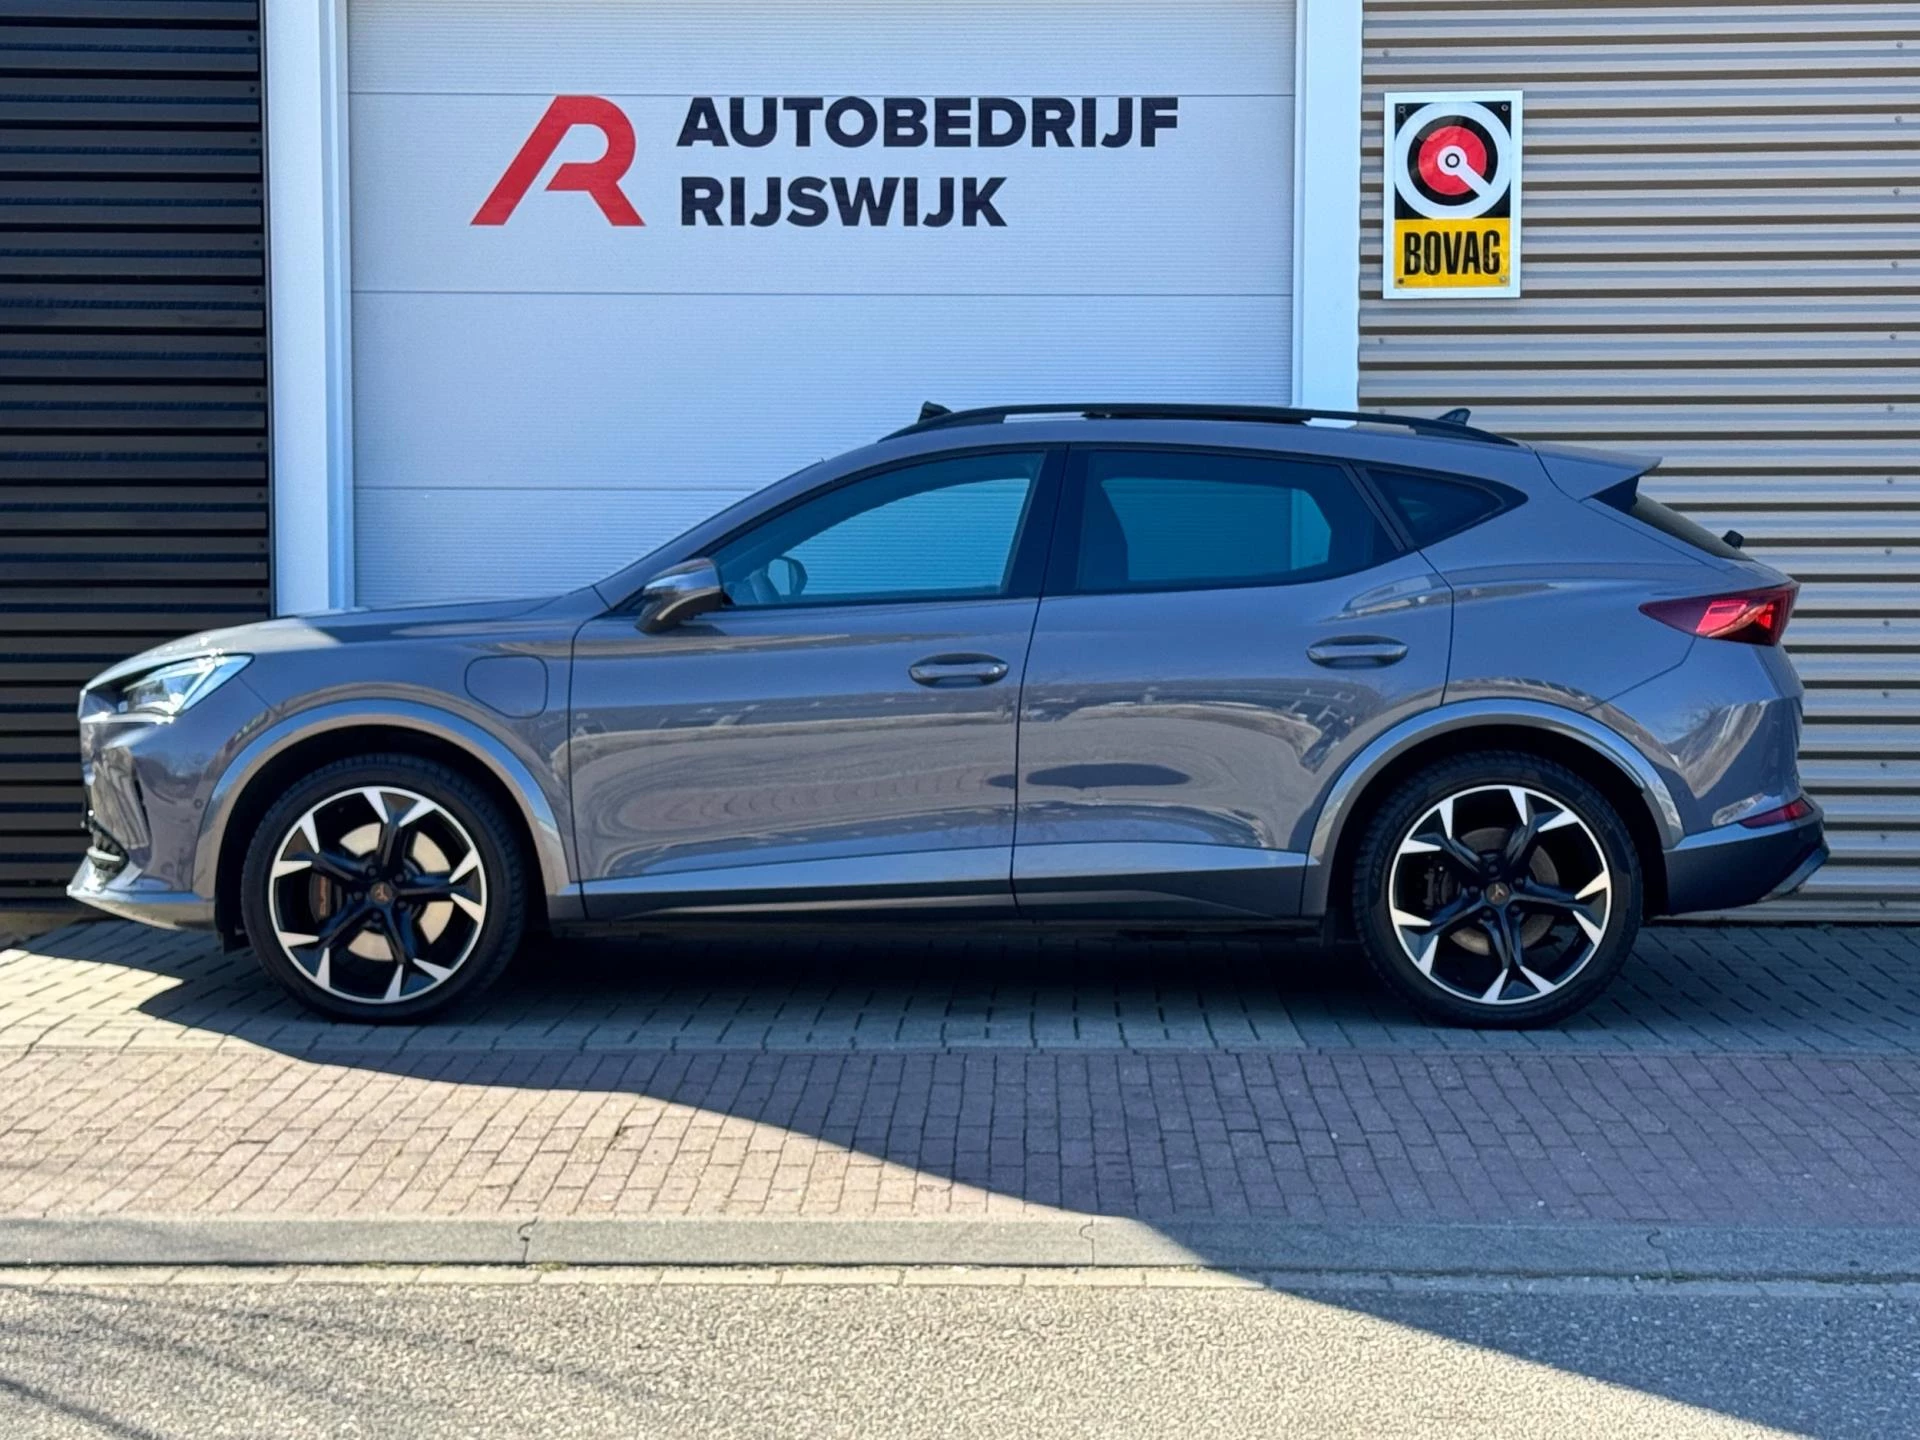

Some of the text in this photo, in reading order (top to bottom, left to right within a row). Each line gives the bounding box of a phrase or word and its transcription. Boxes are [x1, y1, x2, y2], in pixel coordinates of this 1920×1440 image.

[676, 96, 1179, 149] AUTOBEDRIJF
[681, 176, 1008, 228] RIJSWIJK
[1403, 229, 1501, 276] BOVAG
